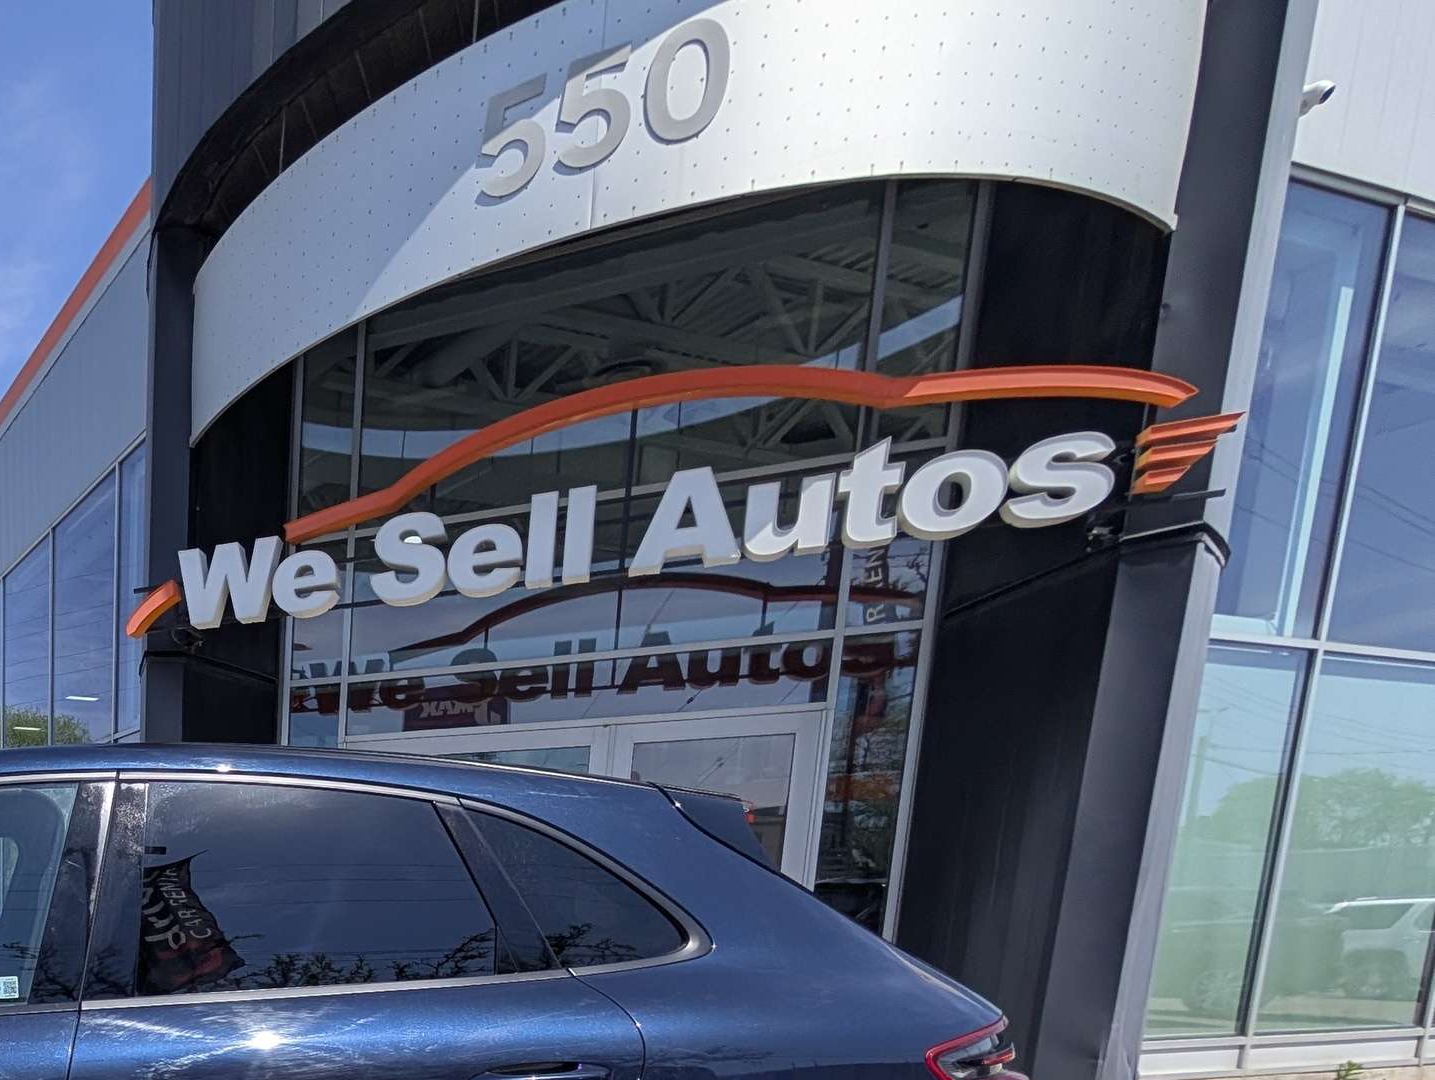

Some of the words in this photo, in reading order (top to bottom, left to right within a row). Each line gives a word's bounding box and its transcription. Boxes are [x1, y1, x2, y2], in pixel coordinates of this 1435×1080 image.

[480, 18, 730, 198] 550
[178, 535, 341, 630] We
[370, 485, 597, 607] Sell
[628, 430, 1117, 577] Autos
